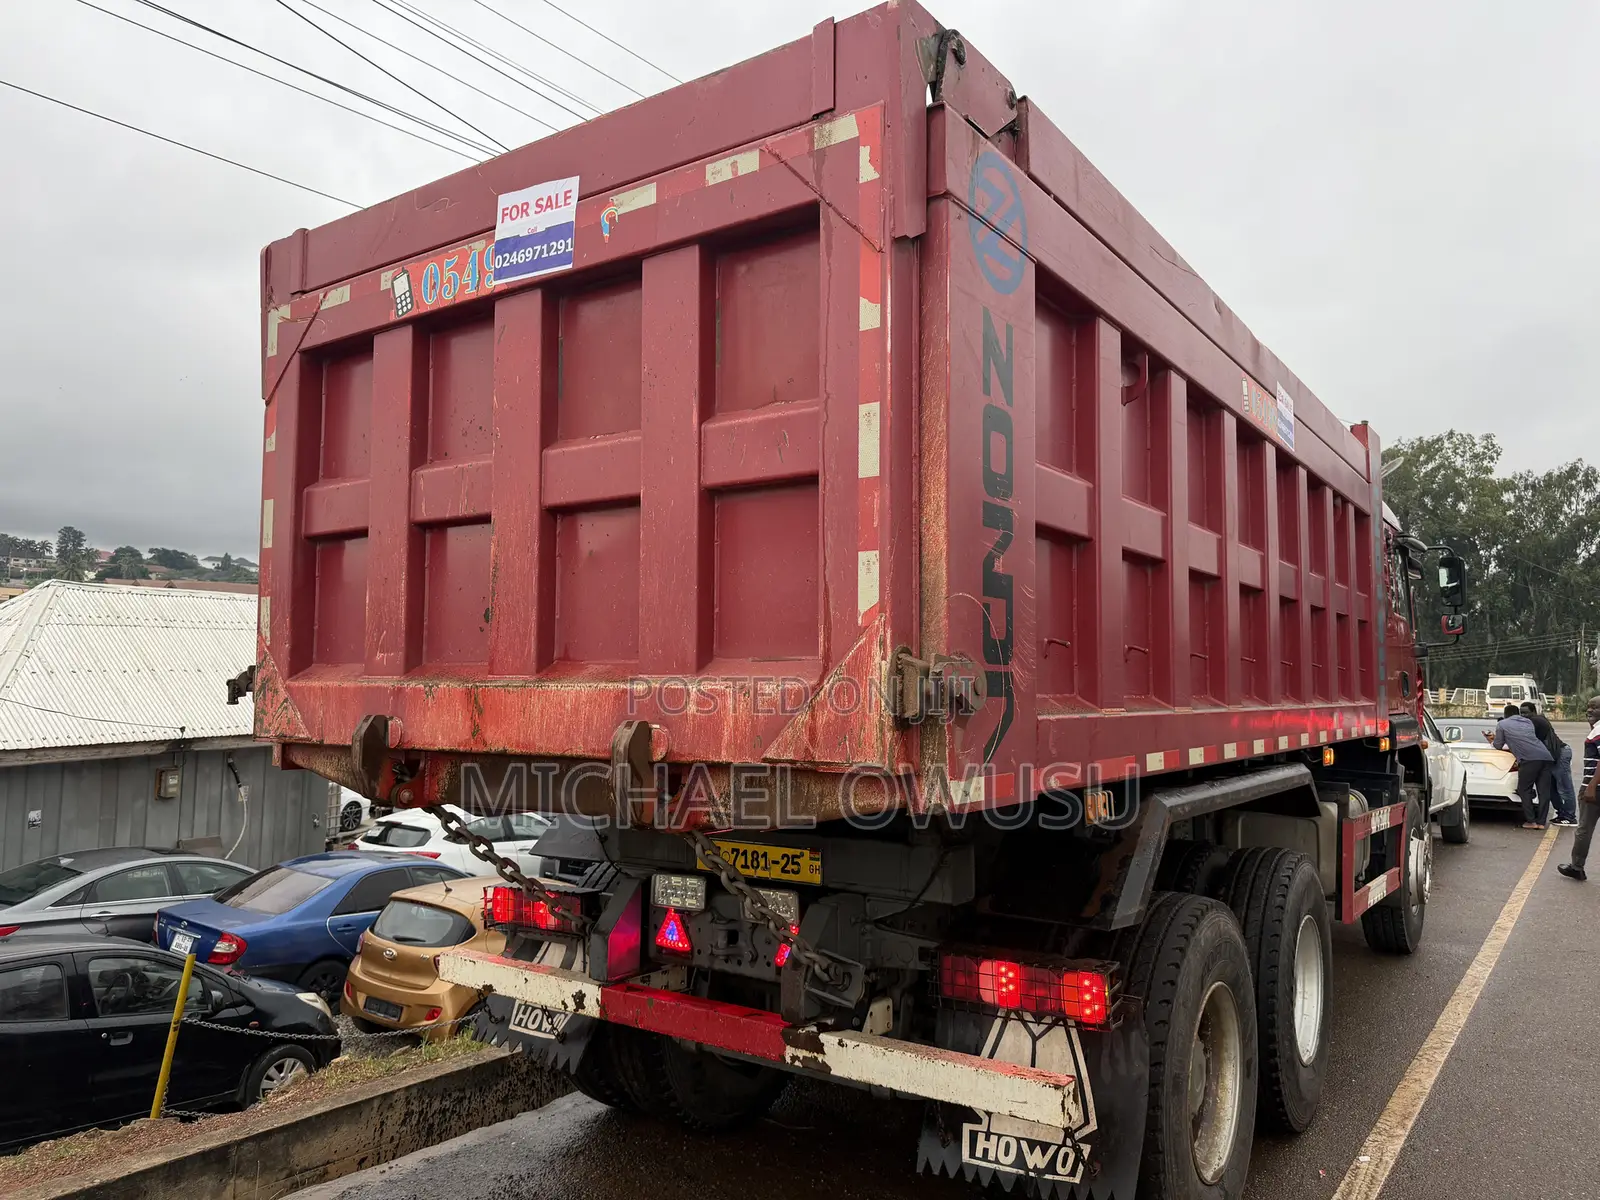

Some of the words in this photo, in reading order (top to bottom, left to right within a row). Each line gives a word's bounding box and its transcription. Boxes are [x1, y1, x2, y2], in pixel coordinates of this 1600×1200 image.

[501, 201, 530, 224] FOR
[534, 189, 572, 215] SALE
[494, 237, 574, 269] 0246971291
[808, 864, 820, 875] GH
[975, 1132, 1076, 1176] HOWO
